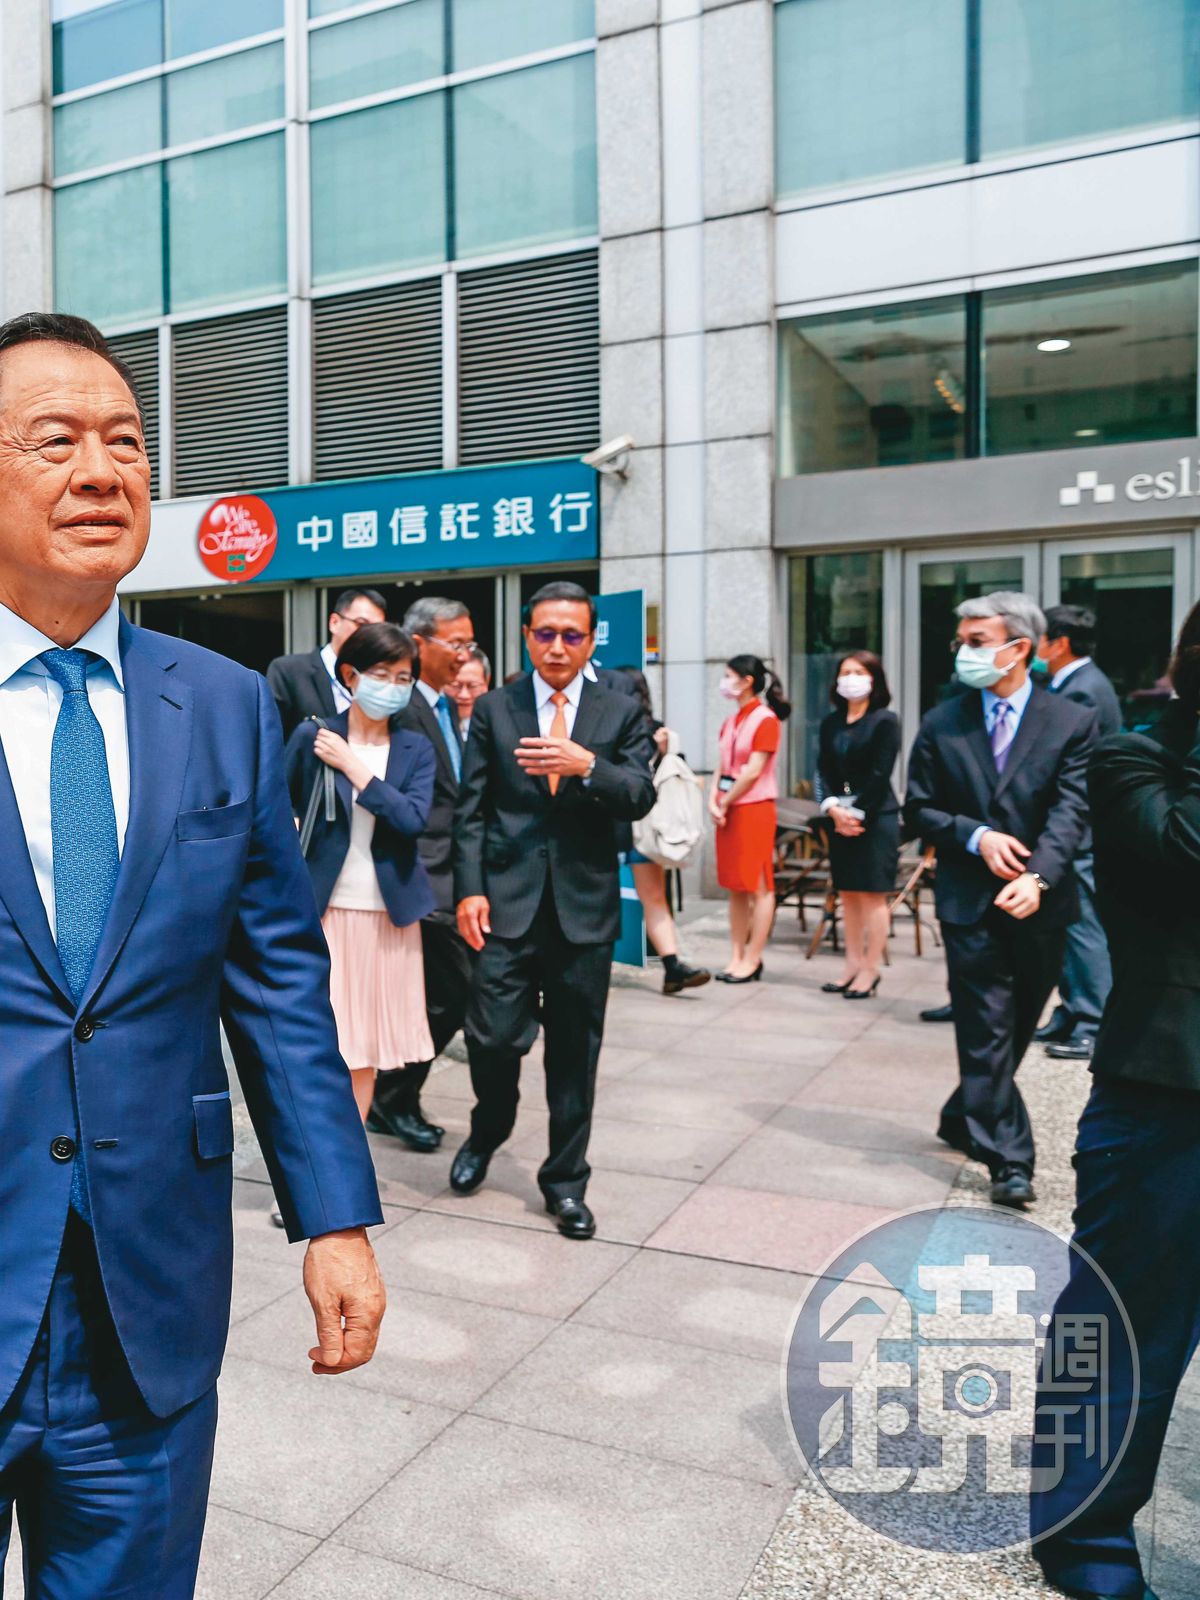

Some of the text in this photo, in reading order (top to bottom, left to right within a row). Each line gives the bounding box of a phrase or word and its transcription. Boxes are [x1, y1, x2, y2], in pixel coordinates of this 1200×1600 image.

[1126, 456, 1200, 501] esl
[297, 491, 592, 552] 中國信託銀行
